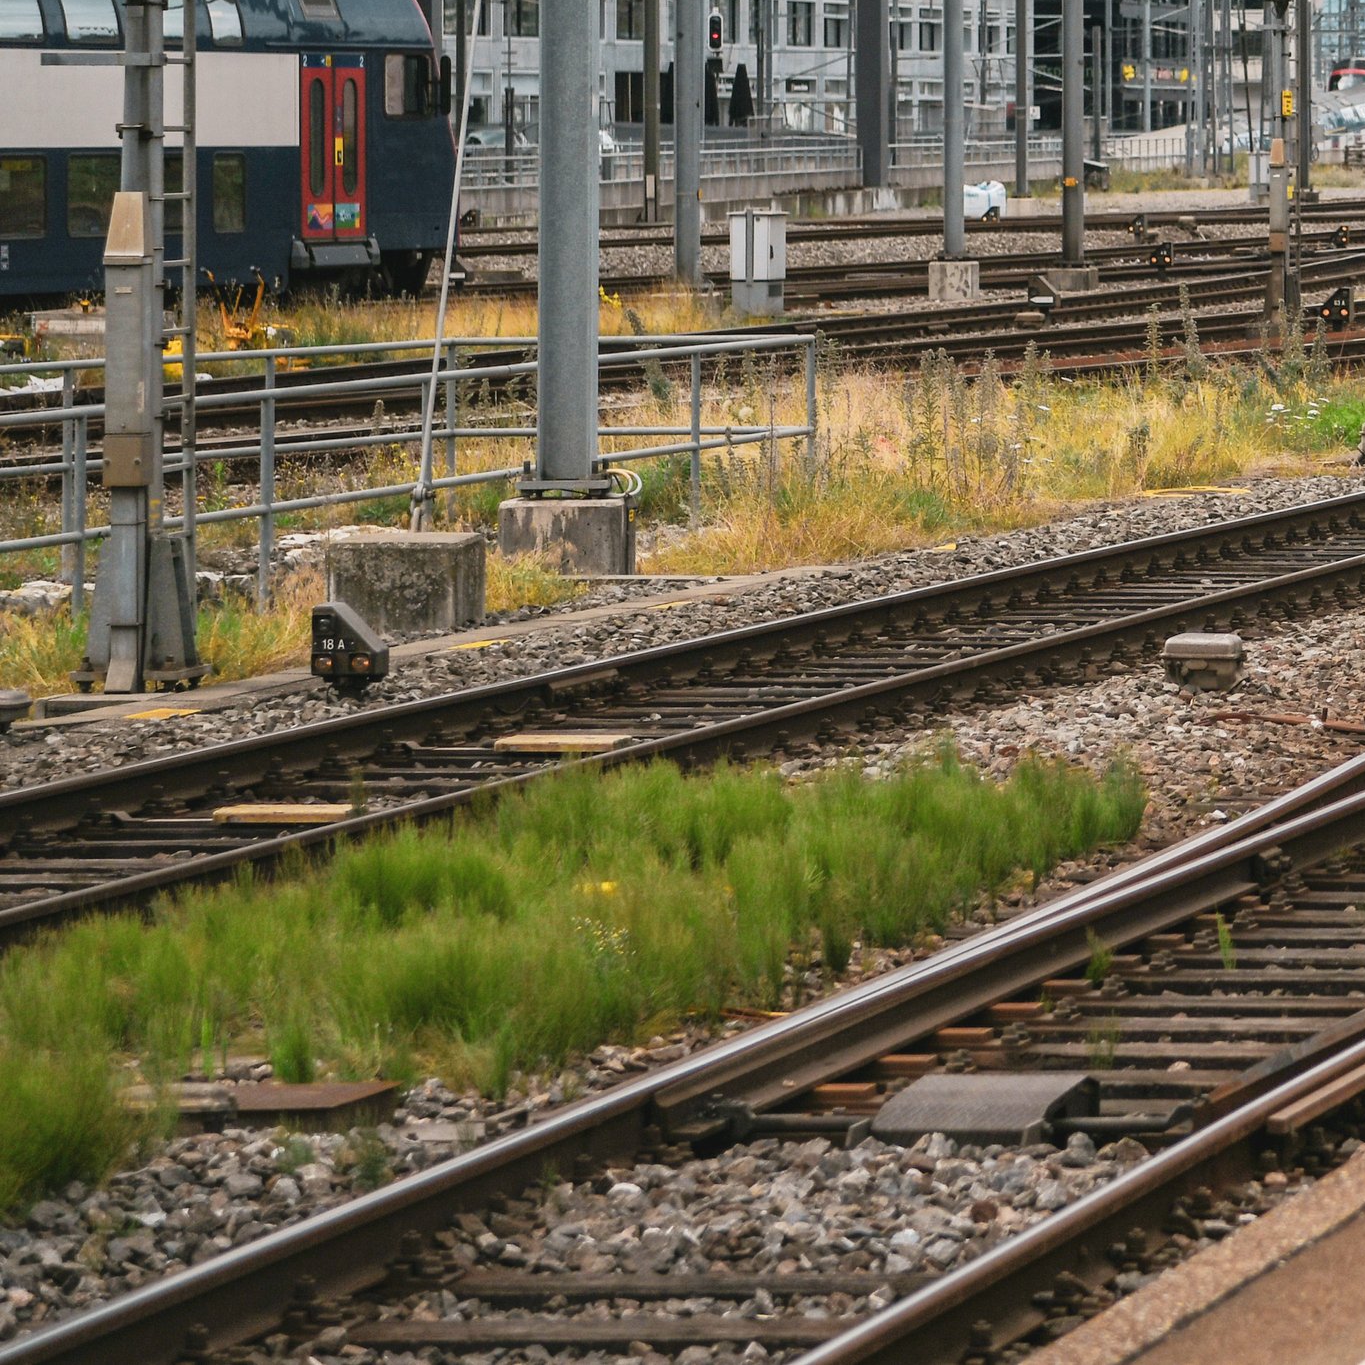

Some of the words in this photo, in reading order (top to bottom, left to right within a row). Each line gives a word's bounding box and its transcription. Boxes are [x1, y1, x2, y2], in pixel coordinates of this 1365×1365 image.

[302, 55, 308, 67] 2
[359, 55, 365, 67] 2
[322, 638, 334, 650] 18
[337, 638, 345, 650] A
